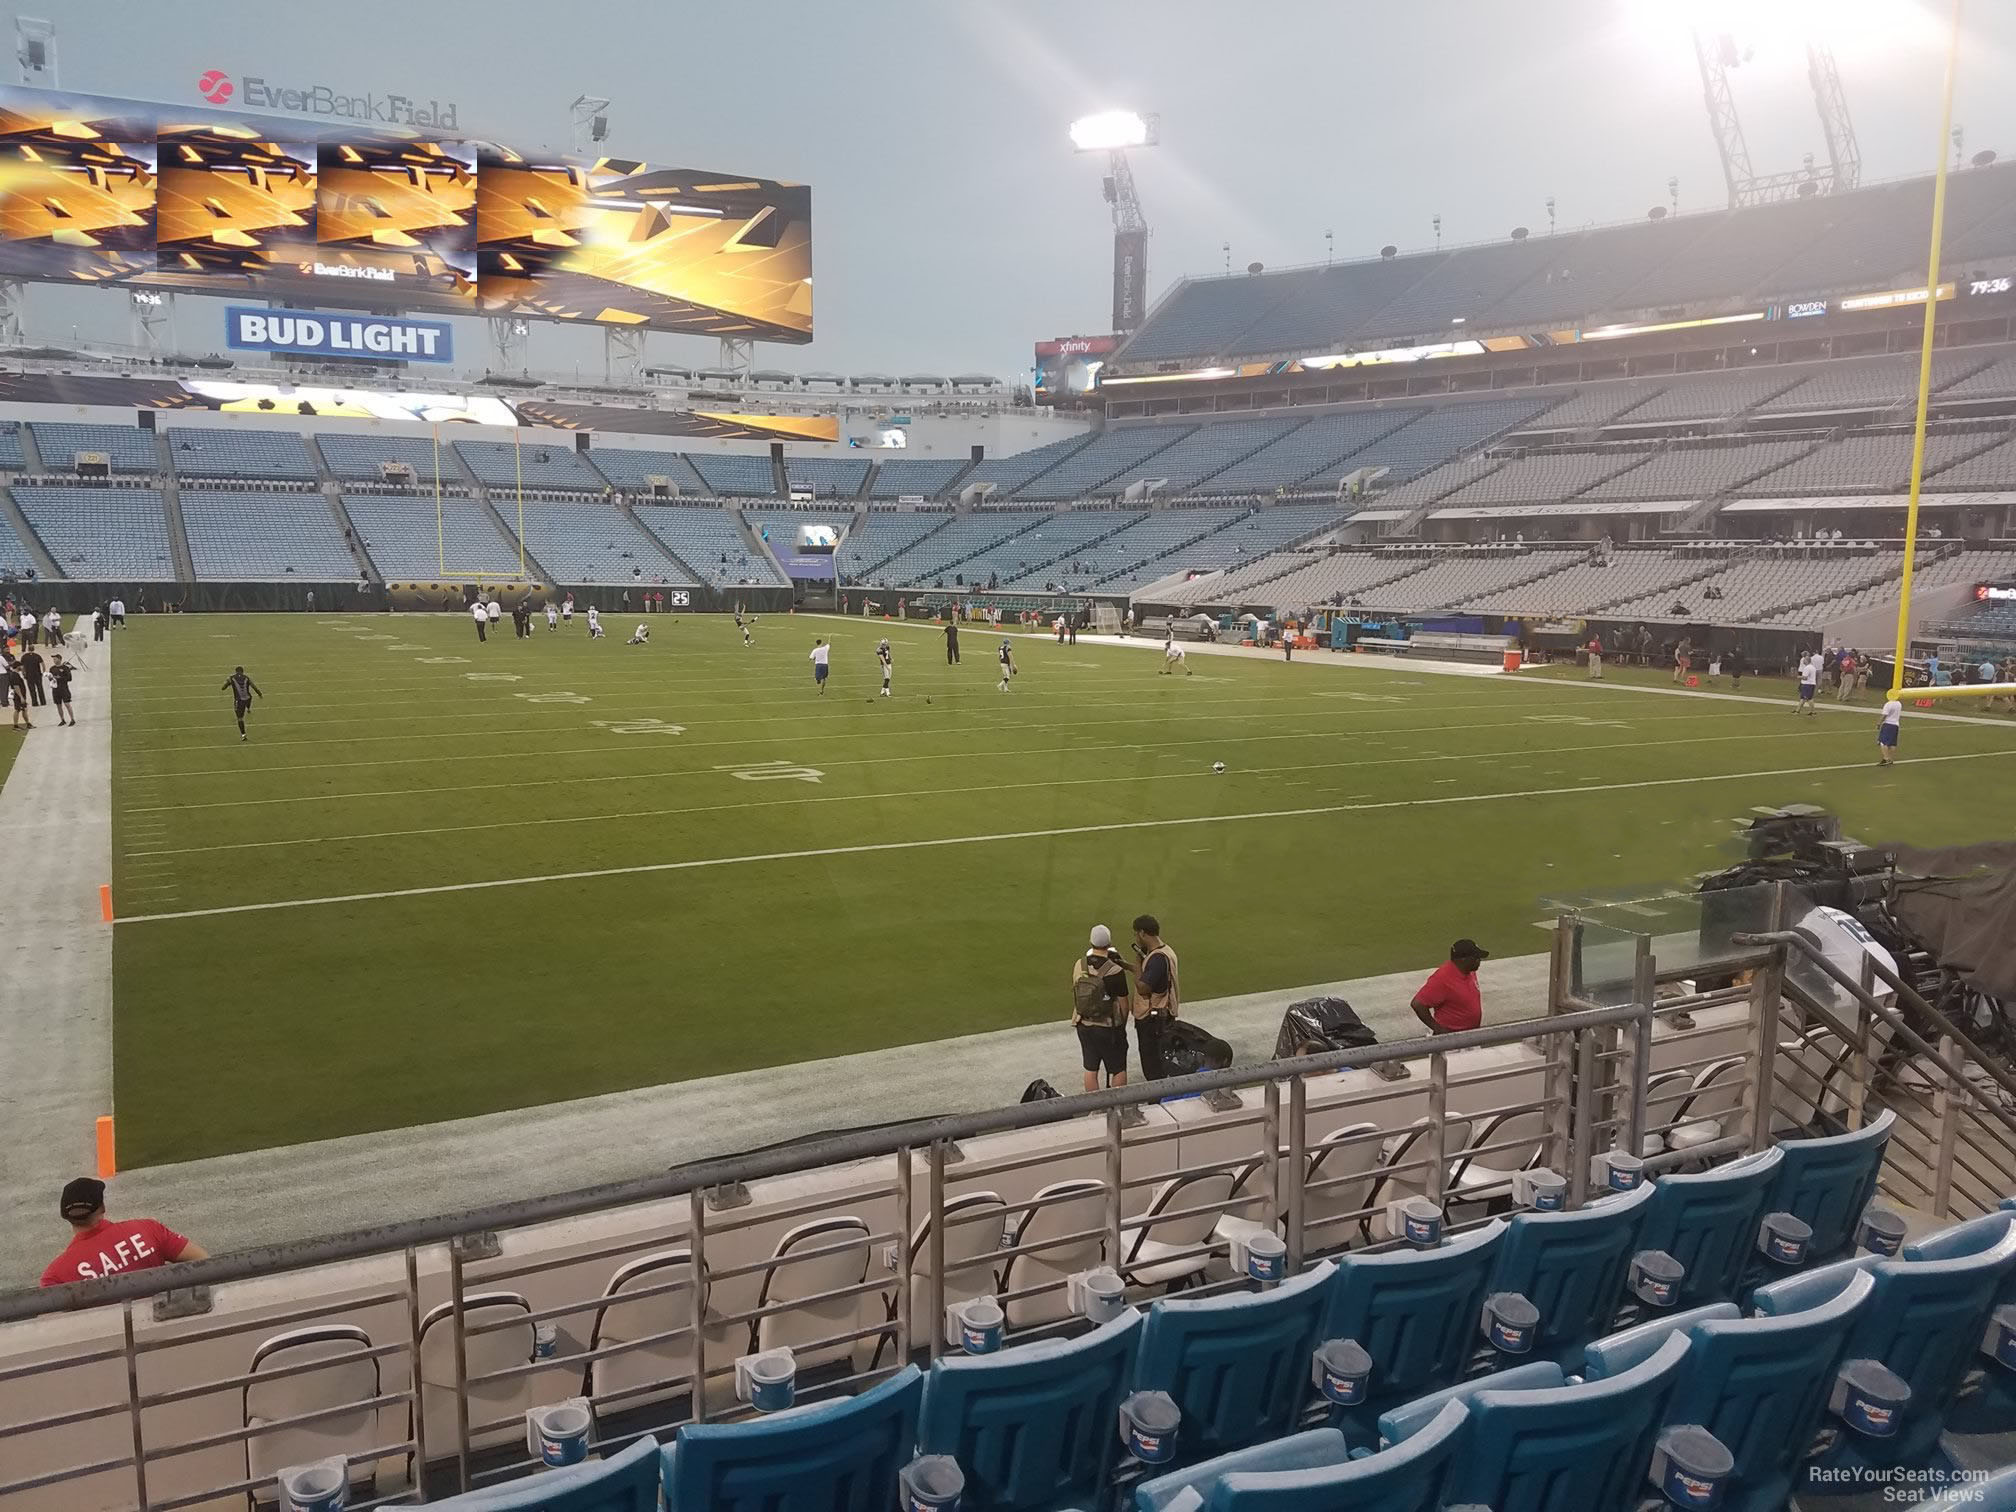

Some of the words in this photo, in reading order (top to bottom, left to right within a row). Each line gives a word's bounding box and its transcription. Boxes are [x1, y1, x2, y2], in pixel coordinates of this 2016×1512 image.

[1970, 277, 2011, 295] 79:36
[1788, 300, 1827, 314] BOWDEN
[240, 314, 324, 346] BUD
[330, 321, 440, 355] LIGHT
[1060, 341, 1091, 353] xfinity
[672, 591, 689, 605] 25
[1774, 1237, 1801, 1250] PEPSI
[1643, 1277, 1671, 1291] PEPSI
[1496, 1322, 1523, 1337] PEPSI
[1326, 1373, 1354, 1389] PEPSI
[1856, 1399, 1893, 1417] PEPSI
[1132, 1428, 1160, 1445] PEPSI
[1674, 1471, 1714, 1491] PEPSI
